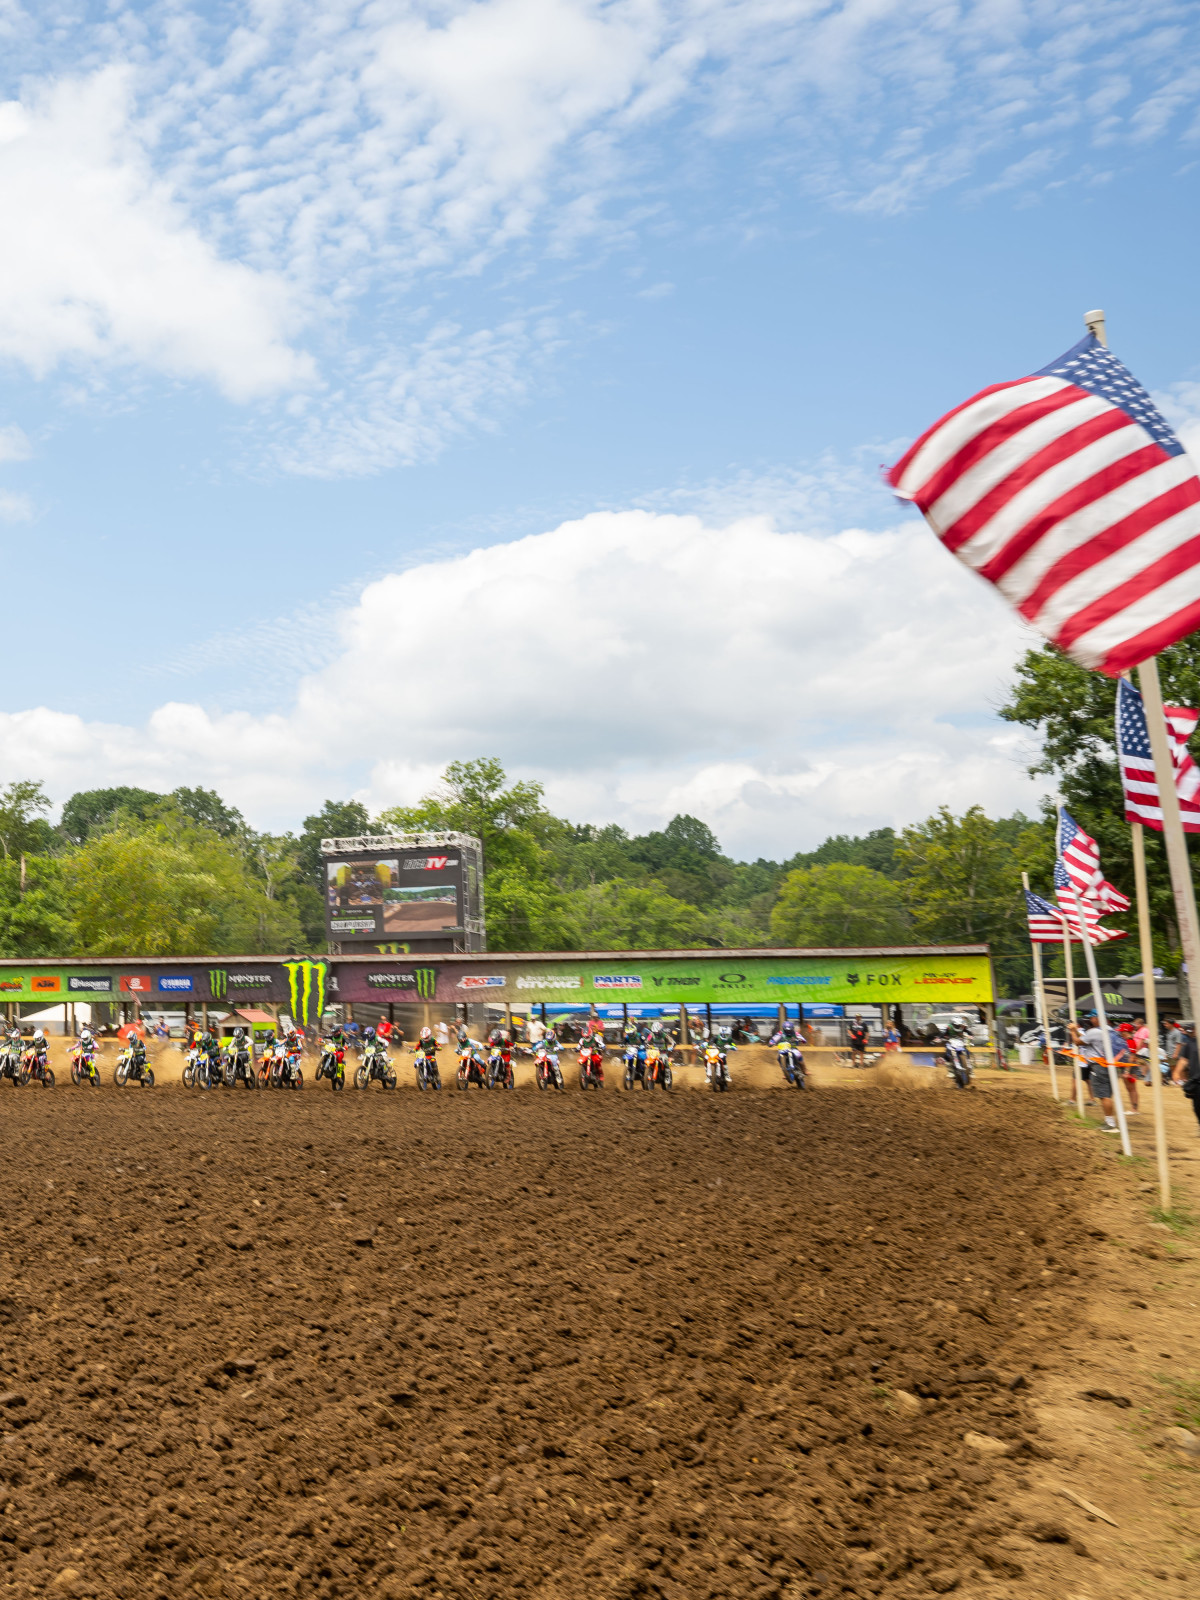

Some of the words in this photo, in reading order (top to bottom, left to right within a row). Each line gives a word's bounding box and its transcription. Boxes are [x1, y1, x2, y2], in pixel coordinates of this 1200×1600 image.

[228, 974, 272, 983] MONSTER
[368, 973, 415, 982] MONSTER
[667, 977, 701, 985] THOR
[867, 974, 902, 986] FOX
[36, 980, 55, 988] KTM
[167, 978, 191, 986] YAMAHA
